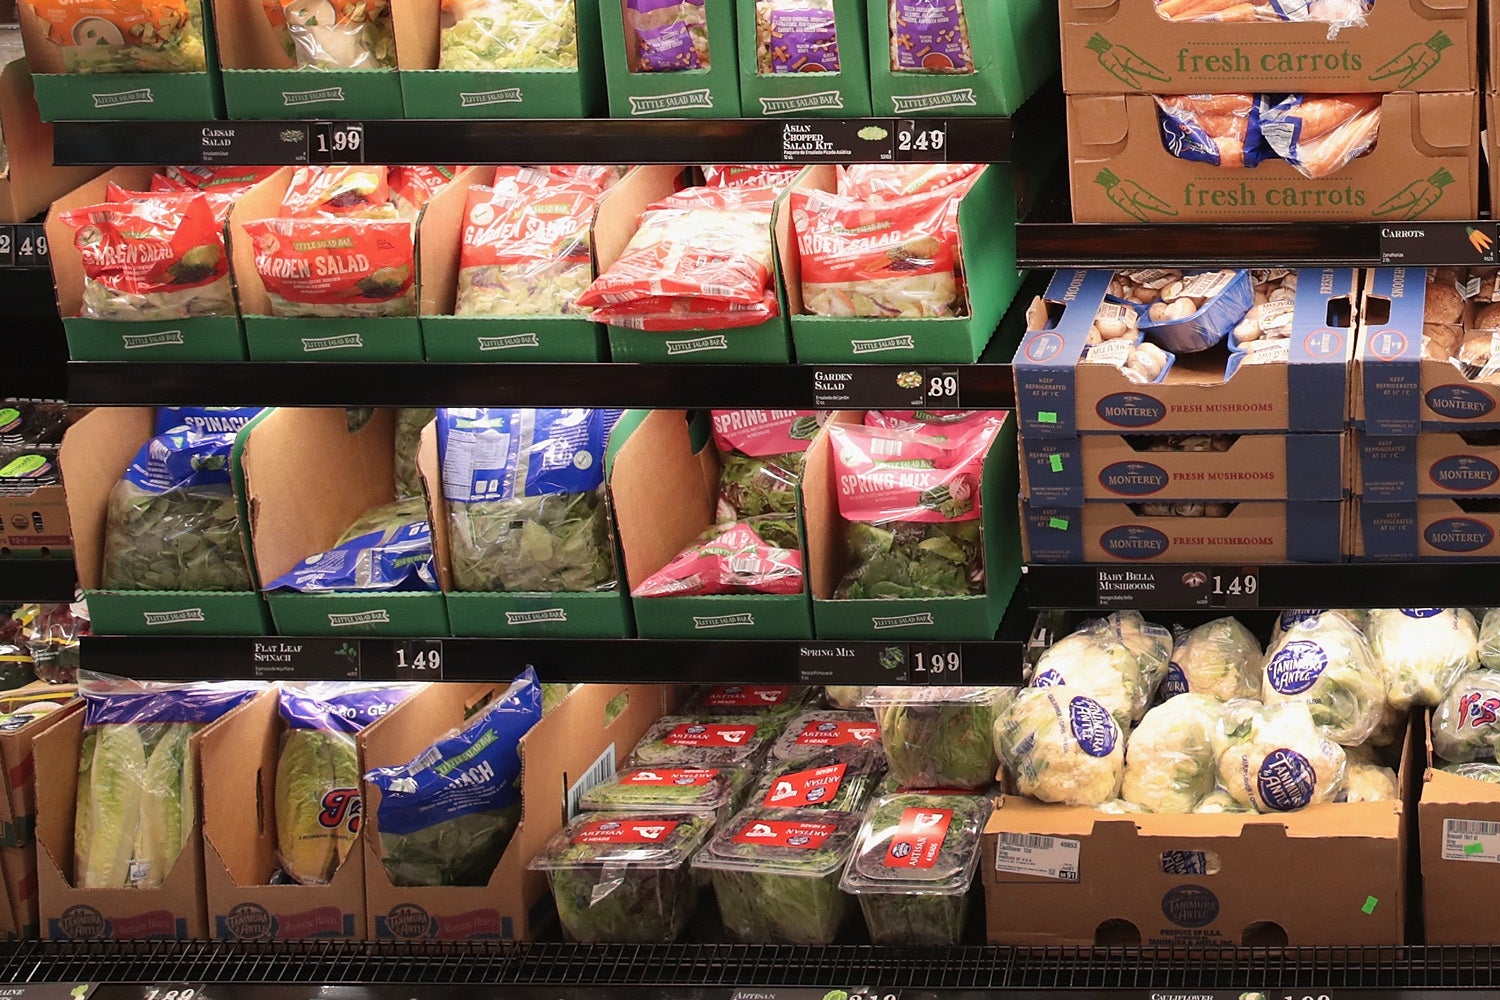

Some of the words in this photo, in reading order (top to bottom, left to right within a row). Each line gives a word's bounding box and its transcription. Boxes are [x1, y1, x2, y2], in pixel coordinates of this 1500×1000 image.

[1177, 47, 1251, 73] fresh
[1260, 50, 1363, 72] carrots
[637, 99, 665, 110] LITTLE
[666, 96, 689, 108] SALAD
[690, 93, 705, 104] BAR
[899, 97, 928, 109] LITTLE
[929, 95, 951, 107] SALAD
[952, 93, 968, 104] BAR
[202, 128, 235, 137] CAESAR
[783, 123, 811, 132] ASIAN
[202, 137, 231, 146] SALAD
[317, 131, 360, 152] 1.99
[783, 132, 824, 141] CHOPPED
[898, 129, 944, 151] 2.49
[783, 142, 813, 150] SALAD
[815, 141, 833, 150] KIT
[1184, 183, 1255, 206] fresh
[1265, 184, 1366, 207] carrots
[1381, 228, 1425, 238] CARROTS
[316, 253, 370, 275] SALAD
[814, 371, 853, 381] GARDEN
[814, 381, 845, 390] SALAD
[927, 376, 957, 397] .89
[1105, 406, 1159, 417] MONTEREY
[1170, 404, 1202, 413] FRESH
[1206, 403, 1273, 413] MUSHROOMS
[1433, 398, 1486, 412] MONTEREY
[1439, 469, 1493, 481] MONTEREY
[841, 471, 894, 496] SPRING
[899, 472, 930, 487] MIX
[1099, 572, 1124, 582] BABY
[1126, 572, 1155, 582] BELLA
[1099, 582, 1155, 591] MUSHROOMS
[1212, 575, 1257, 595] 1.49
[254, 643, 279, 653] FLAT
[280, 643, 303, 653] LEAF
[800, 647, 835, 657] SPRING
[837, 647, 856, 657] MIX
[254, 653, 291, 662] SPINACH
[396, 648, 441, 670] 1.49
[914, 652, 960, 675] 1.99
[580, 829, 624, 837] ARTISAN
[734, 991, 776, 1000] ARTISAN
